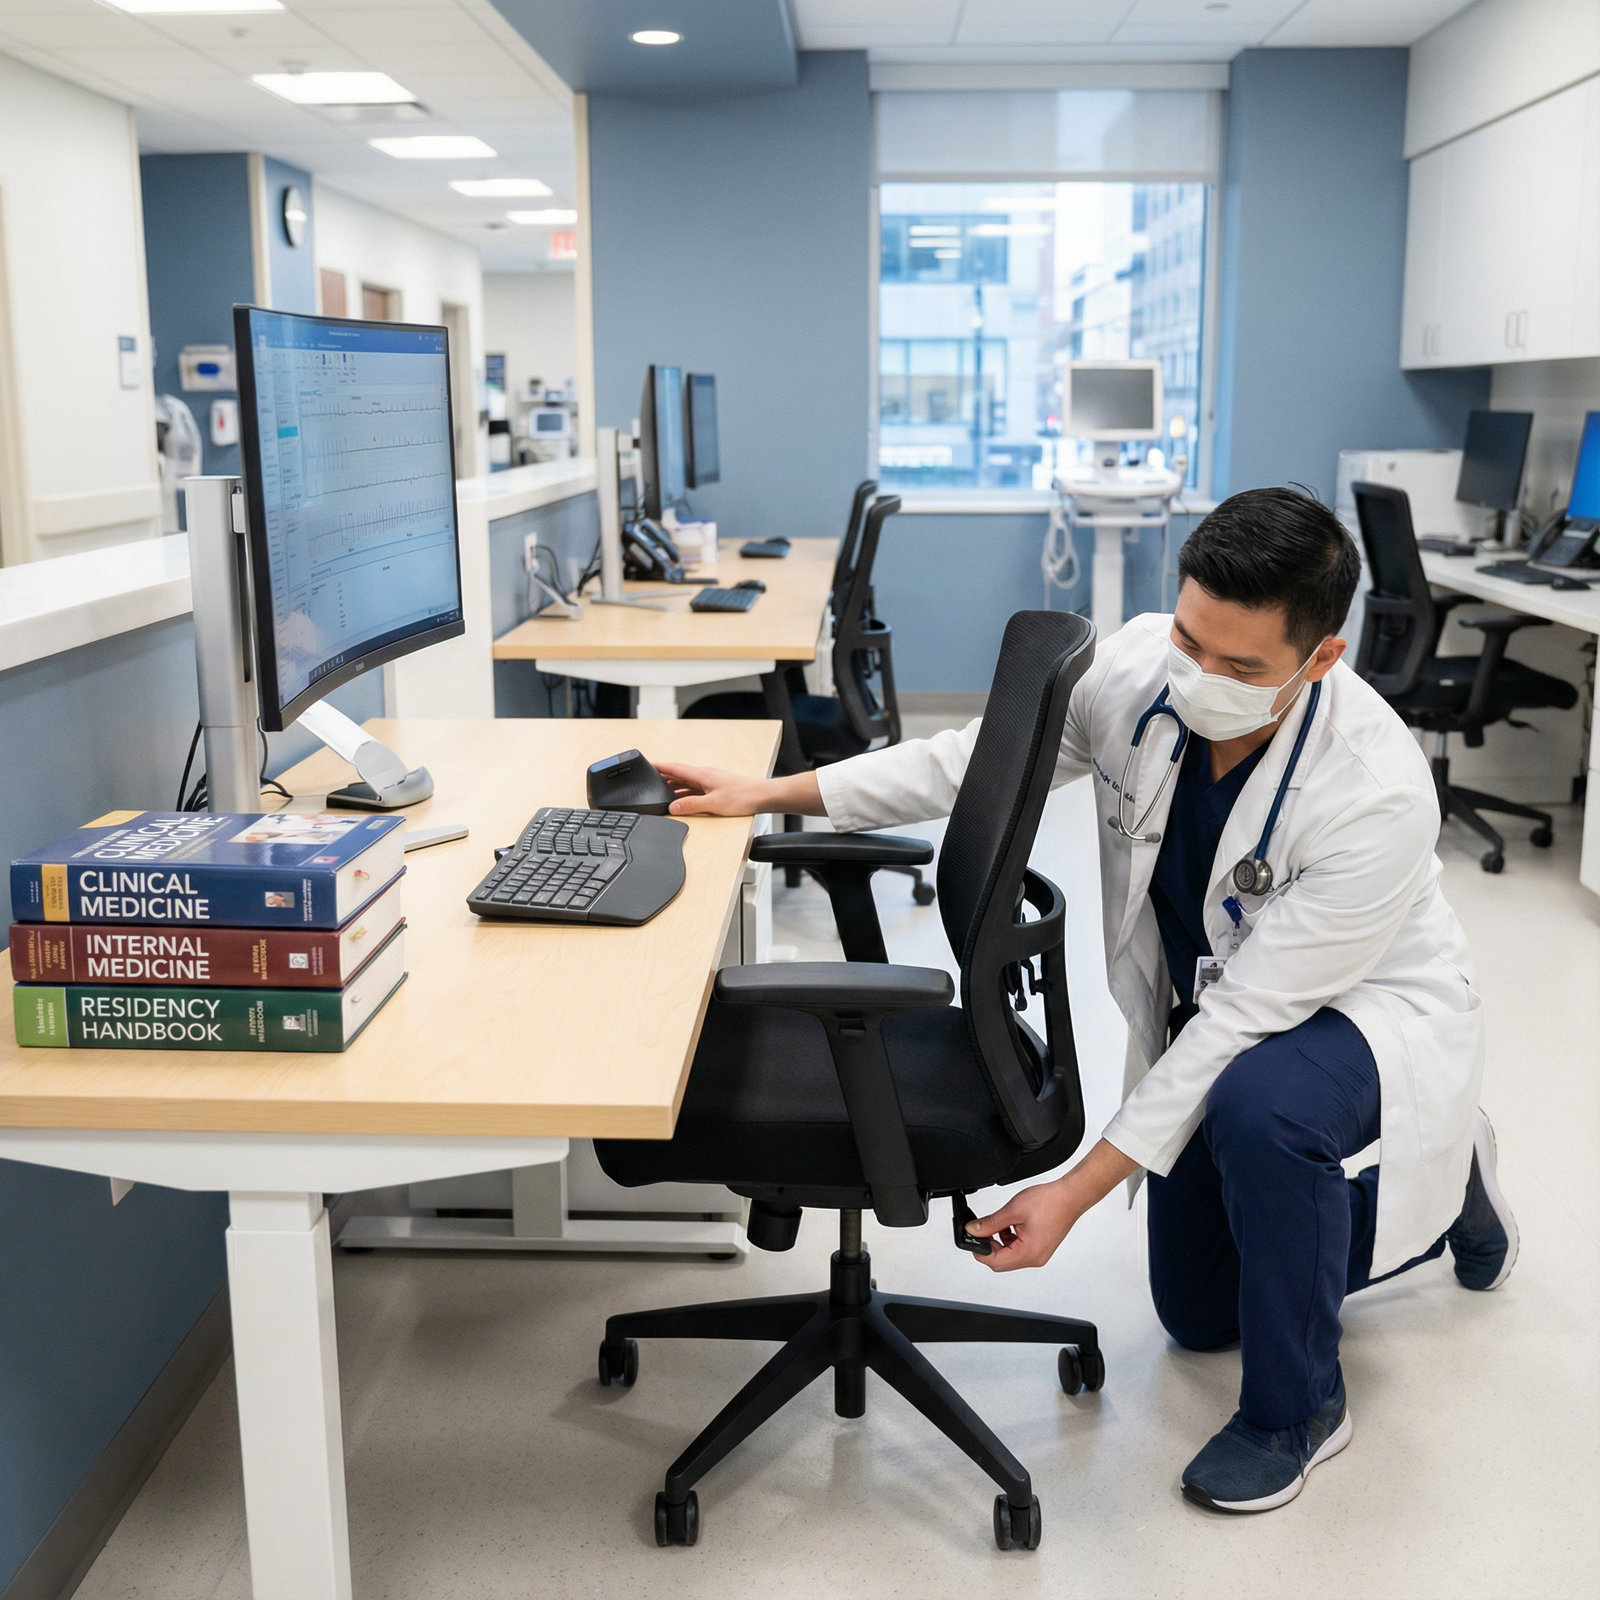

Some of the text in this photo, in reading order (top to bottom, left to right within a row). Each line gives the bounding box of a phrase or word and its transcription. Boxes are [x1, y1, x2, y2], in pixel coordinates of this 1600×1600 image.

[93, 816, 189, 859] CLINICAL
[124, 816, 228, 860] MEDICINE
[79, 870, 199, 895] CLINICAL
[80, 895, 211, 920] MEDICINE
[86, 934, 210, 957] INTERNAL
[87, 957, 211, 980] MEDICINE
[80, 996, 221, 1019] RESIDENCY
[82, 1021, 223, 1042] HANDBOOK
